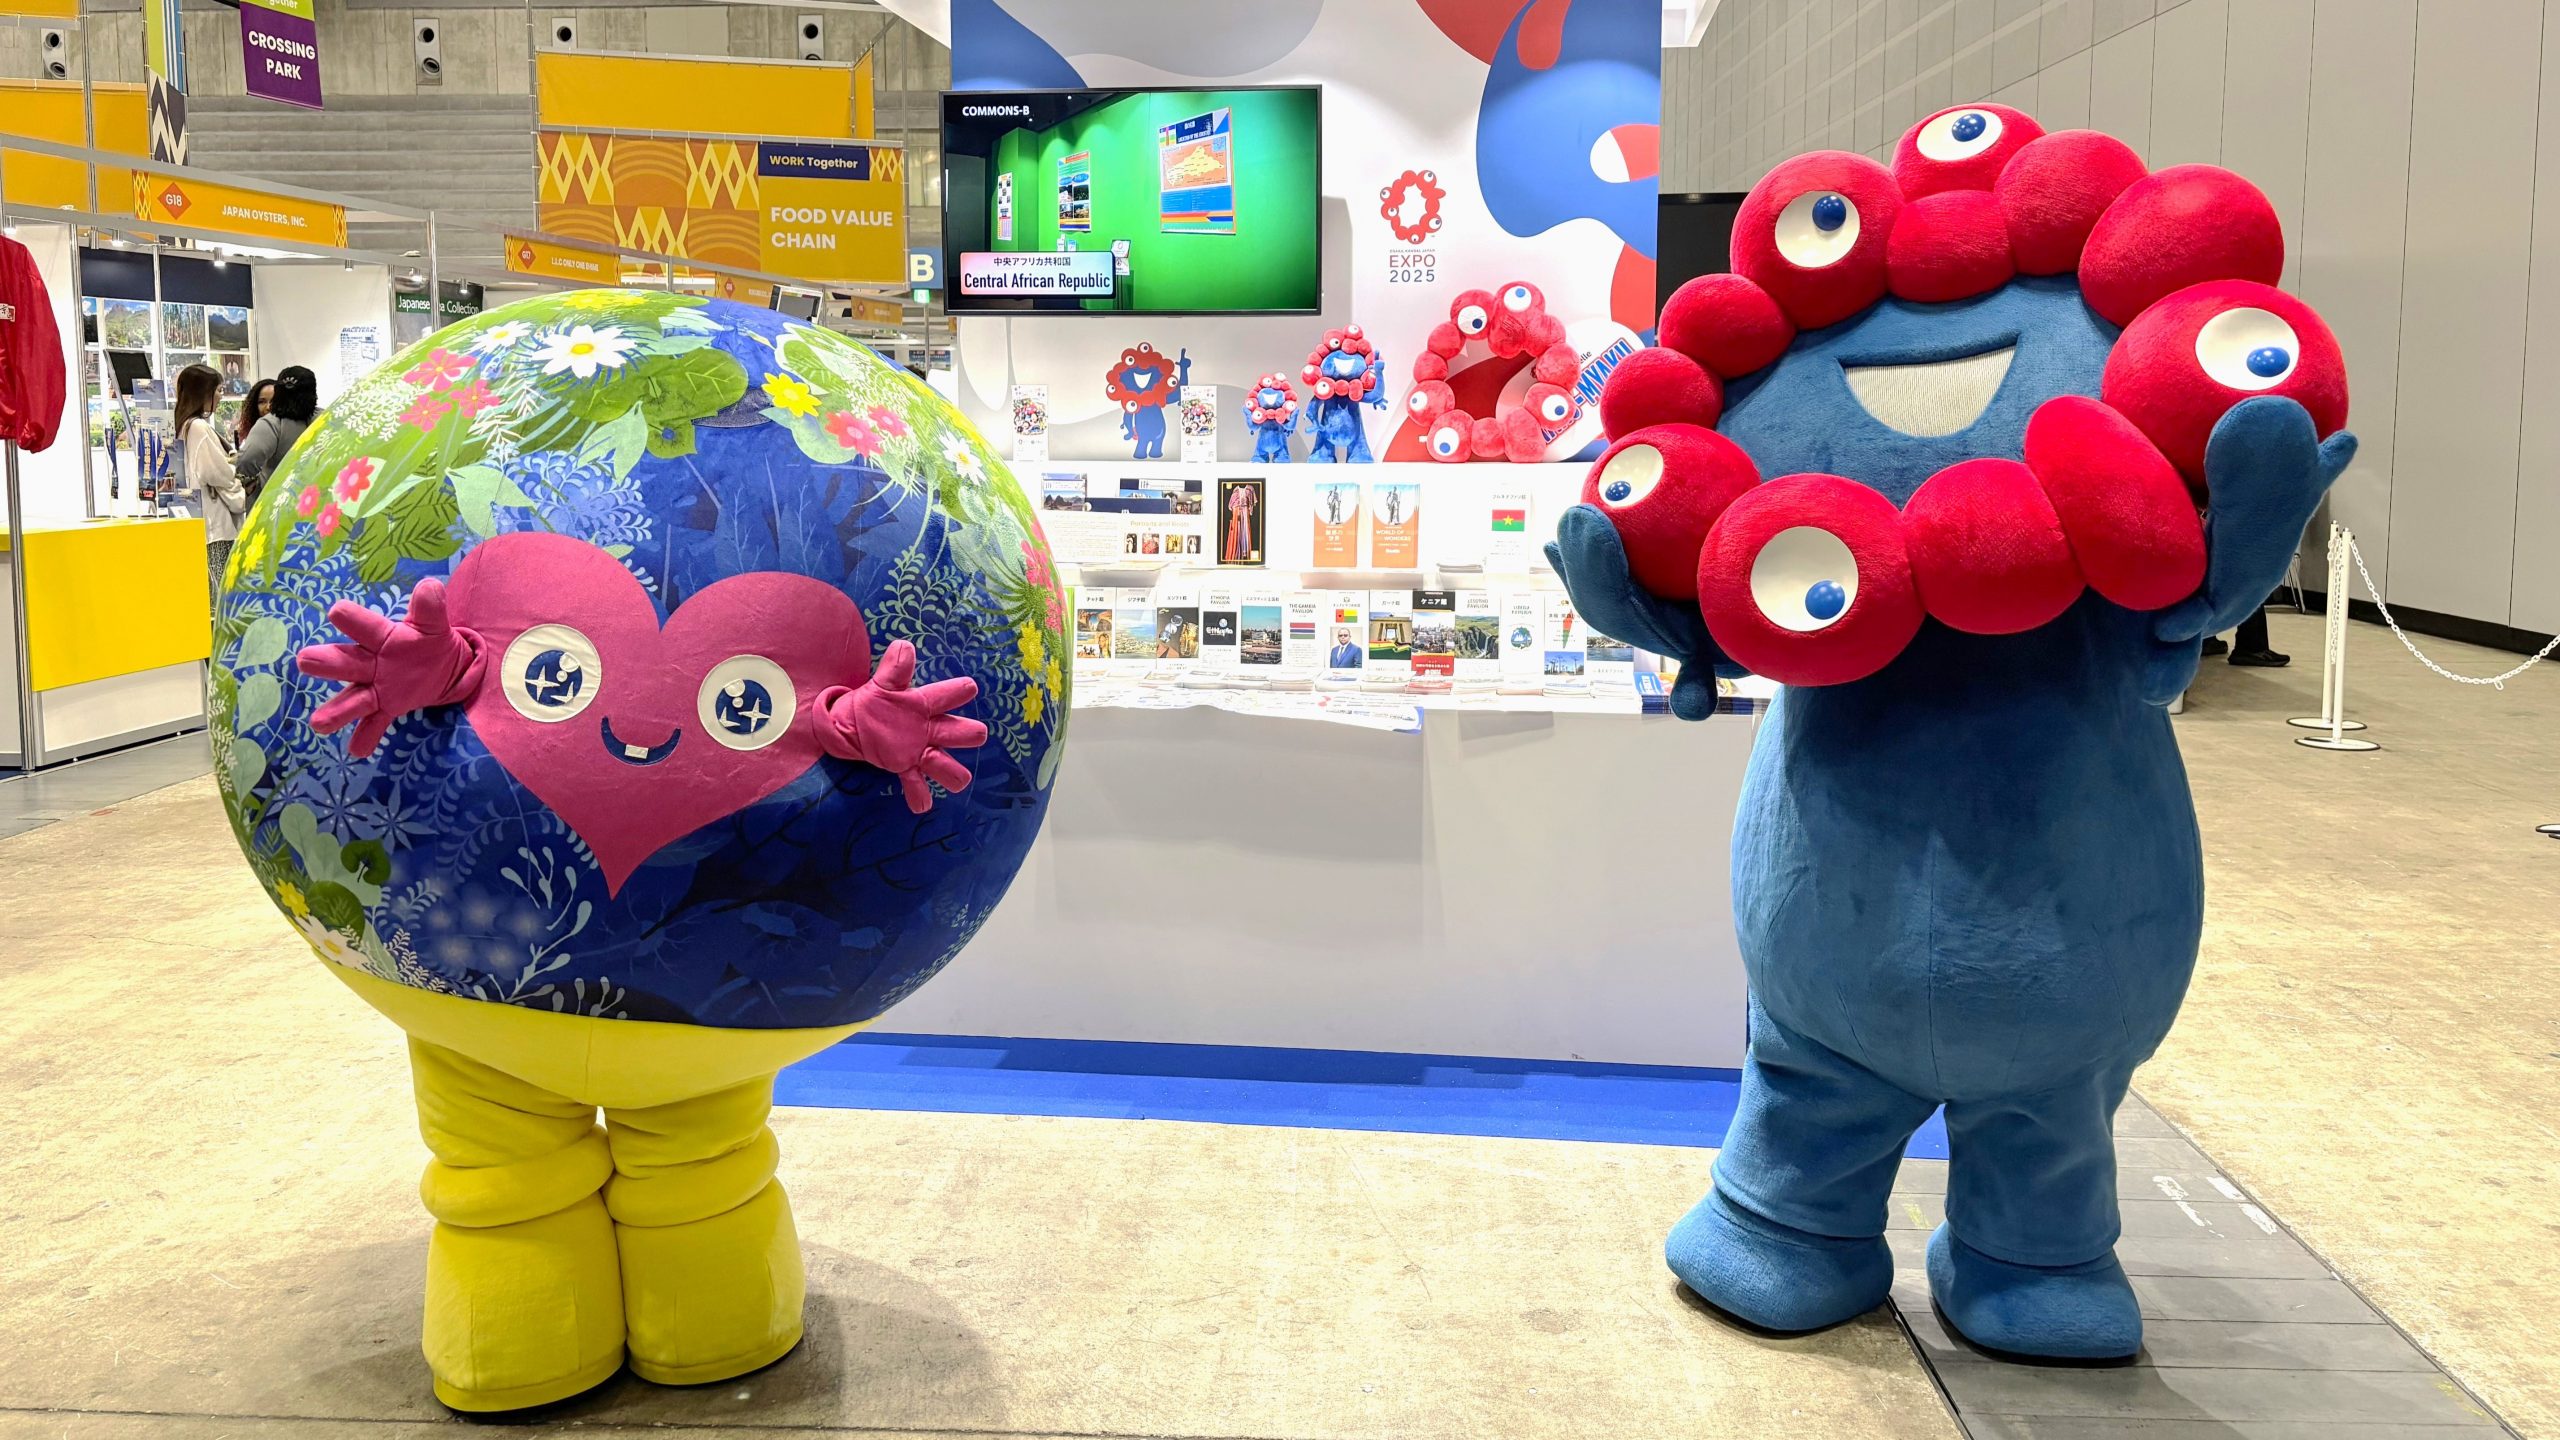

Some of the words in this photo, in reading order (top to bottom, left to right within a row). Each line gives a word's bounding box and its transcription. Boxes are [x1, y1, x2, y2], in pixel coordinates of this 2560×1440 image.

[268, 0, 298, 9] gether
[248, 31, 316, 60] CROSSING
[266, 58, 302, 80] PARK
[962, 105, 1030, 117] COMMONS-B
[769, 155, 805, 166] WORK
[807, 156, 858, 170] Together
[165, 193, 183, 207] G18
[222, 204, 251, 219] JAPAN
[252, 209, 290, 226] OYSTERS,
[291, 215, 308, 228] INC.
[771, 207, 826, 224] FOOD
[831, 209, 893, 226] VALUE
[771, 232, 836, 249] CHAIN
[910, 254, 935, 282] B
[993, 256, 1071, 267] 中央アフリカ共和国
[1389, 254, 1436, 268] EXPO
[964, 273, 1008, 288] Central
[1011, 273, 1055, 288] African
[1058, 273, 1110, 291] Republic
[1389, 269, 1435, 283] 2025
[398, 295, 431, 312] Japanese
[446, 300, 480, 315] Collection
